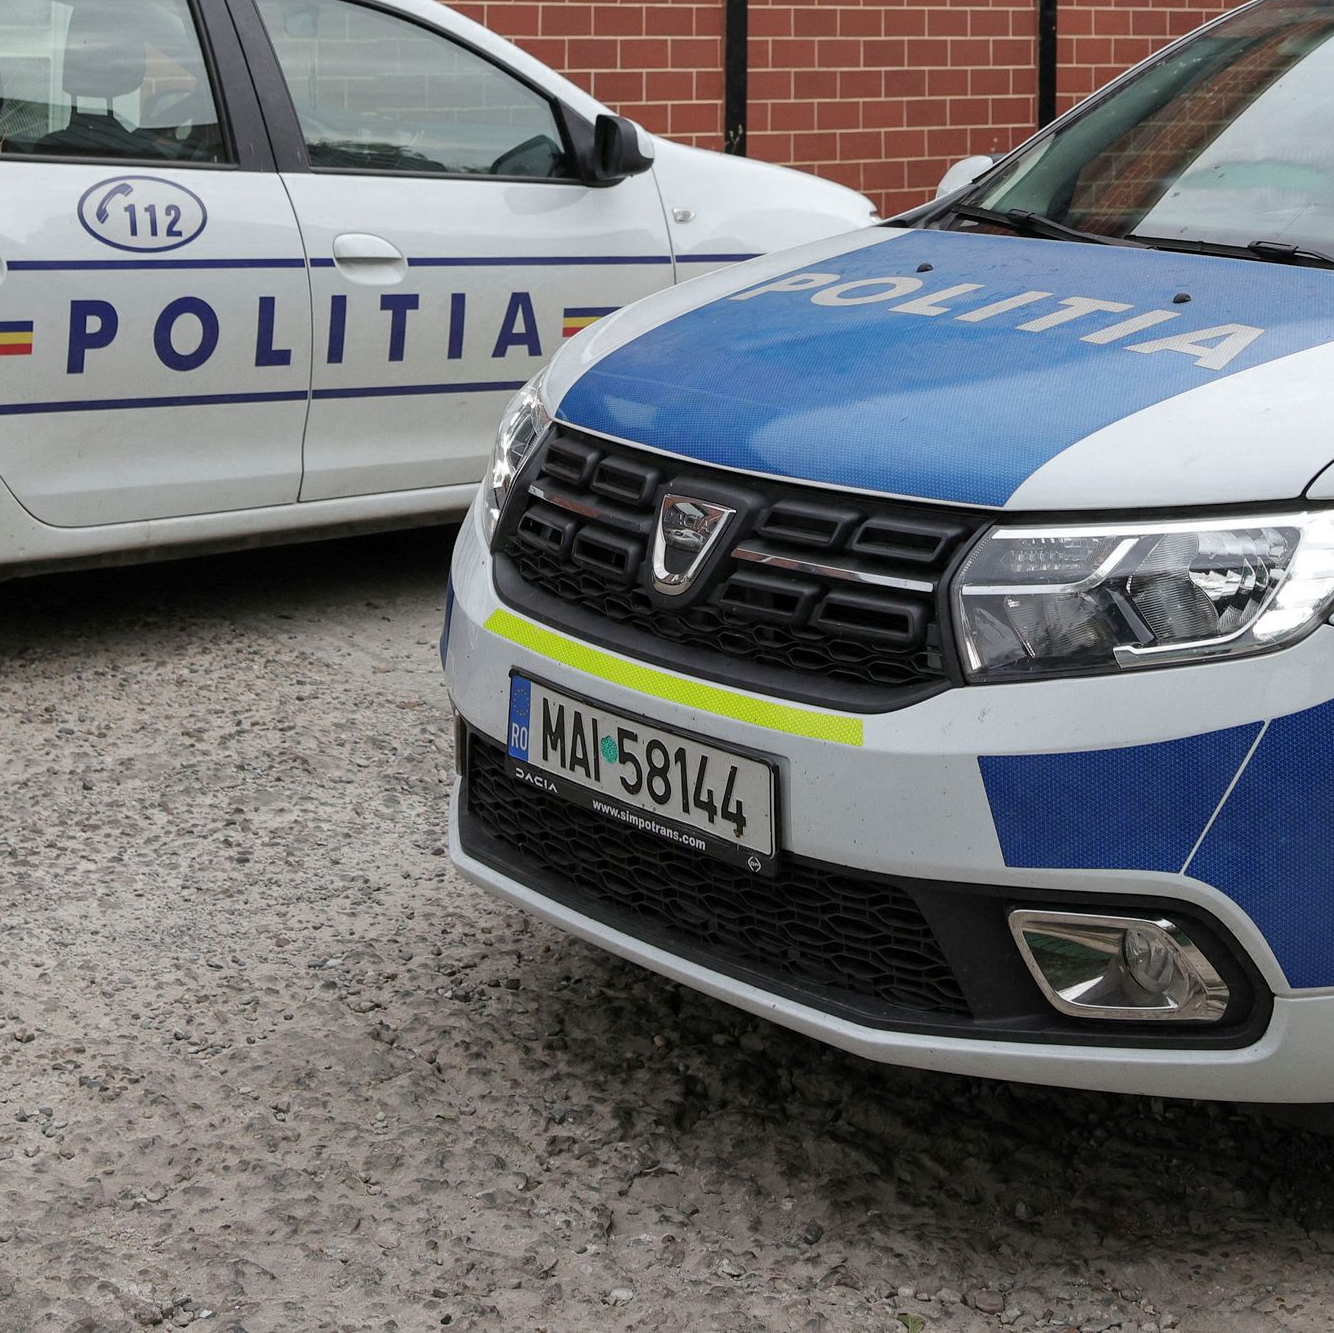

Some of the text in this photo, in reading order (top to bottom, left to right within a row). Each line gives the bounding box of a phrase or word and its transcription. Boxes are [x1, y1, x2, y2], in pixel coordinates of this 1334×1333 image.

[123, 203, 183, 237] 112
[67, 292, 543, 374] POLITIA
[728, 273, 1267, 371] POLITIA
[511, 697, 747, 838] RO MAI 58144
[515, 767, 558, 794] DACIA
[592, 799, 706, 851] www.simpotrans.com
